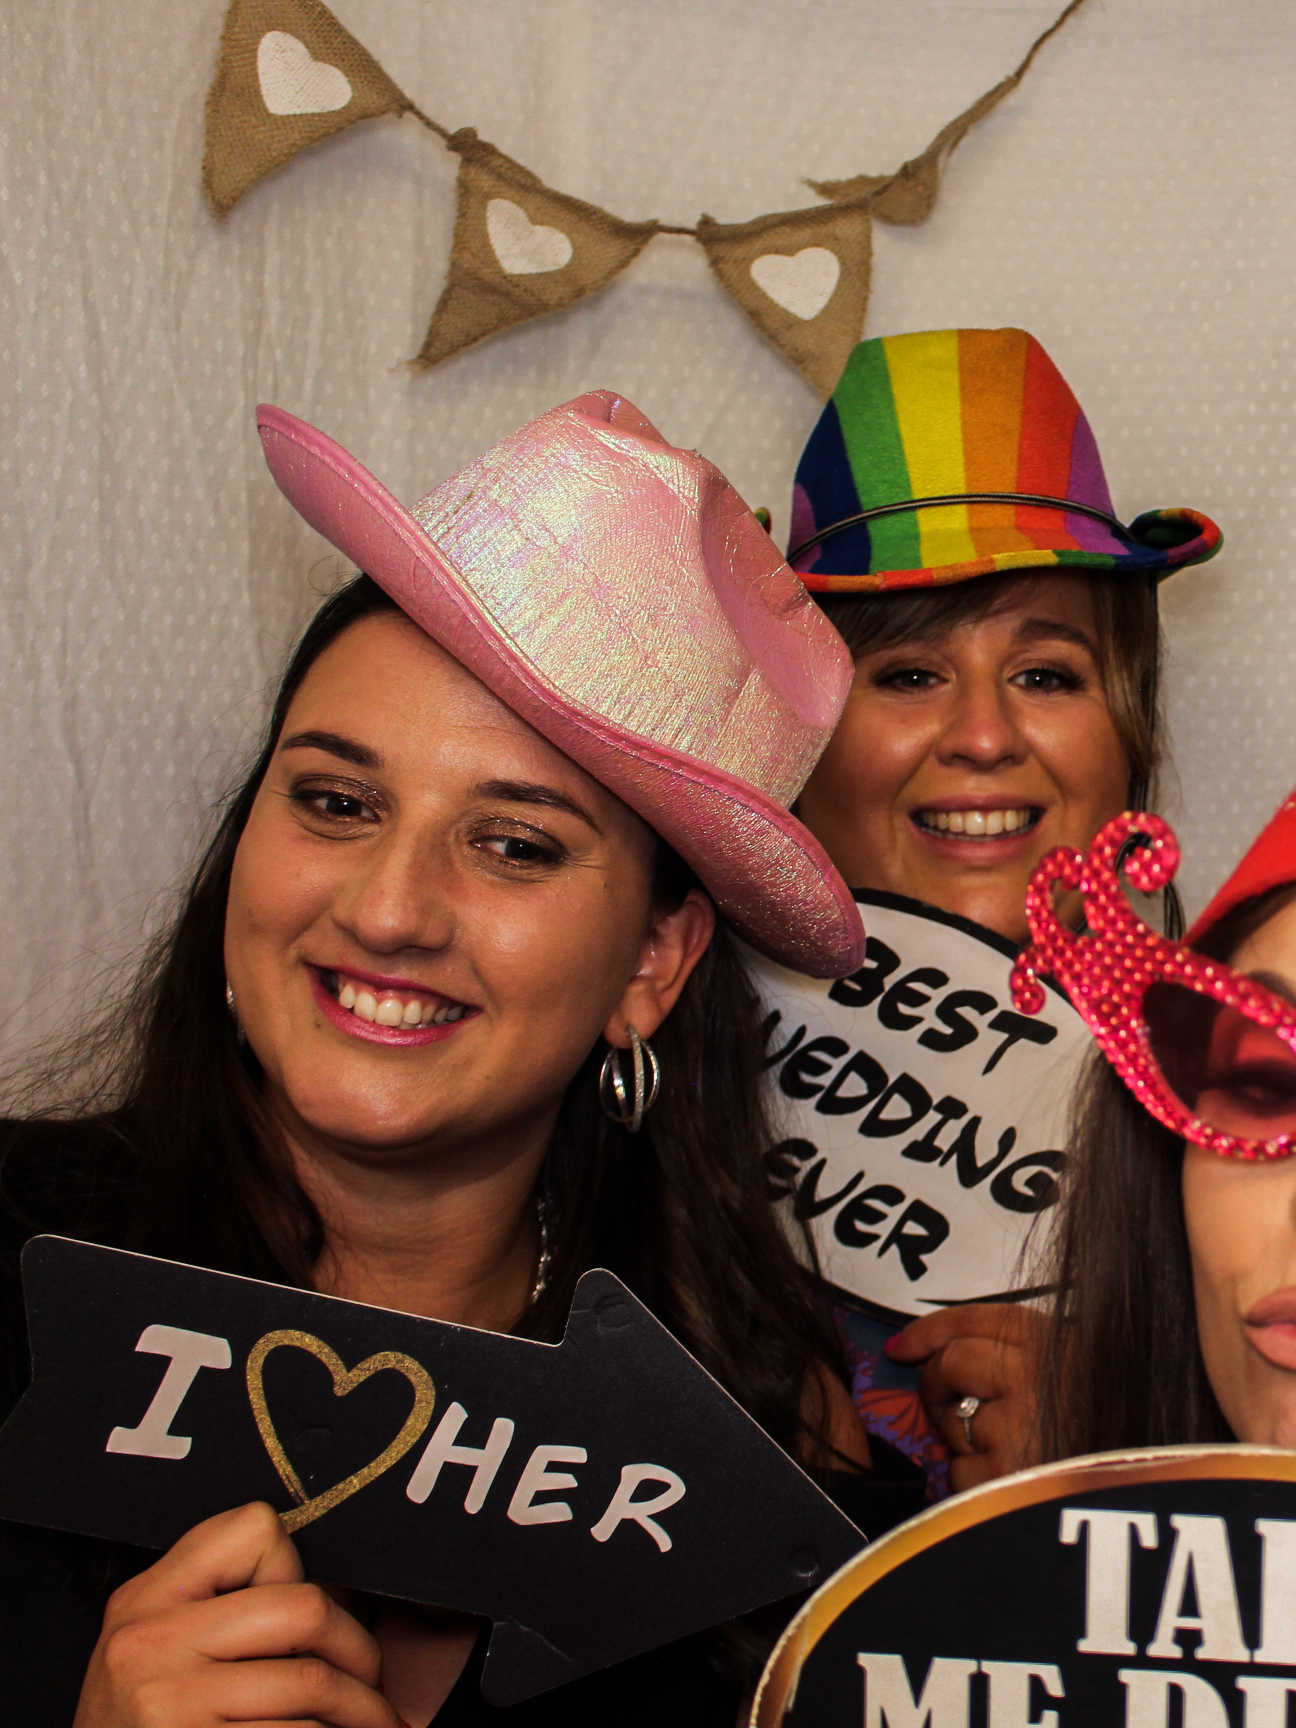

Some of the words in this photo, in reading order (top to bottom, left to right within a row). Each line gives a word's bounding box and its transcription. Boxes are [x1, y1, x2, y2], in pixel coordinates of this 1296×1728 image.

[828, 936, 1058, 1076] BEST
[763, 1138, 950, 1282] EVER
[106, 1324, 231, 1459] I
[406, 1402, 686, 1553] HER
